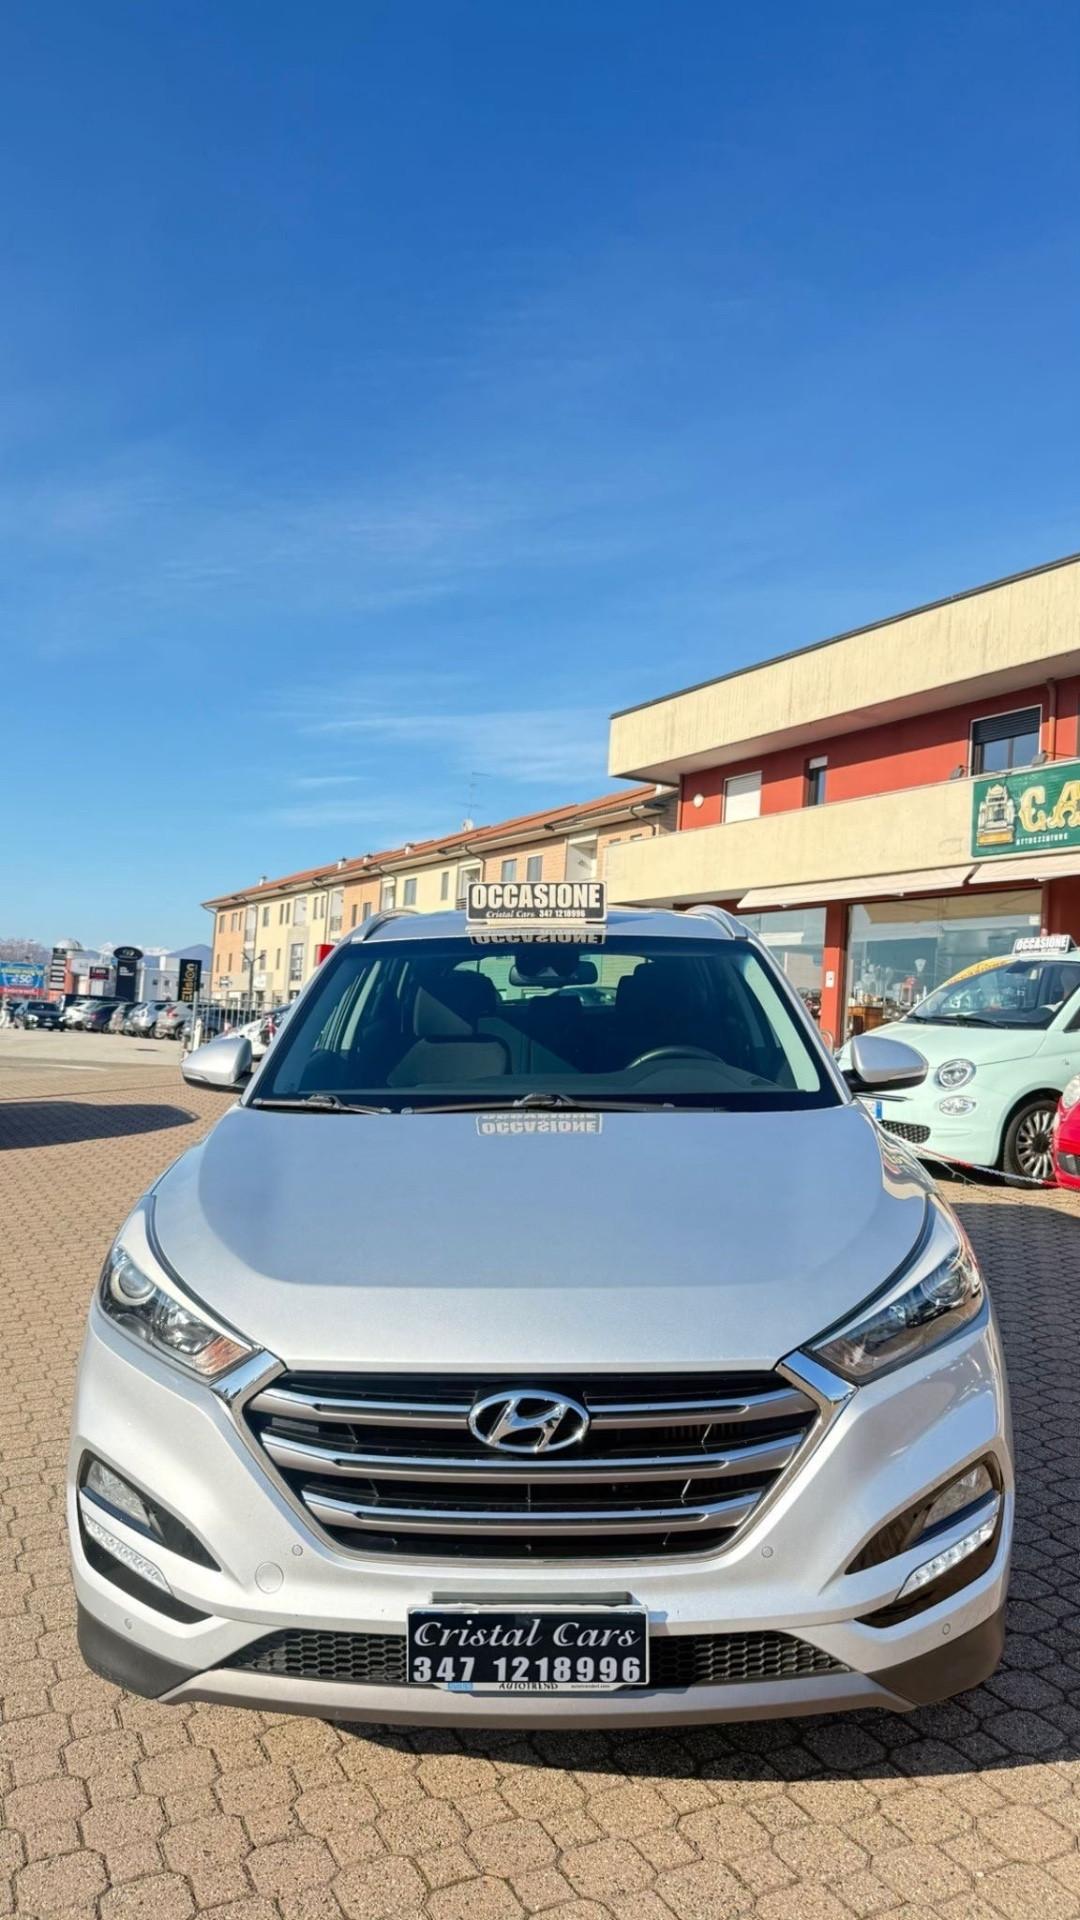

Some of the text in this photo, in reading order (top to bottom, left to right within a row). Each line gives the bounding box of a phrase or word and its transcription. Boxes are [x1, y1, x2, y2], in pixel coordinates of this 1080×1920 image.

[471, 884, 601, 909] OCCASIONE
[486, 909, 586, 918] Cristal Cars 347 1218996
[1016, 934, 1068, 950] OCCASIONE
[414, 1619, 641, 1648] Cristal Cars
[413, 1656, 641, 1682] 347 1218996
[499, 1682, 558, 1691] AUTOTREND
